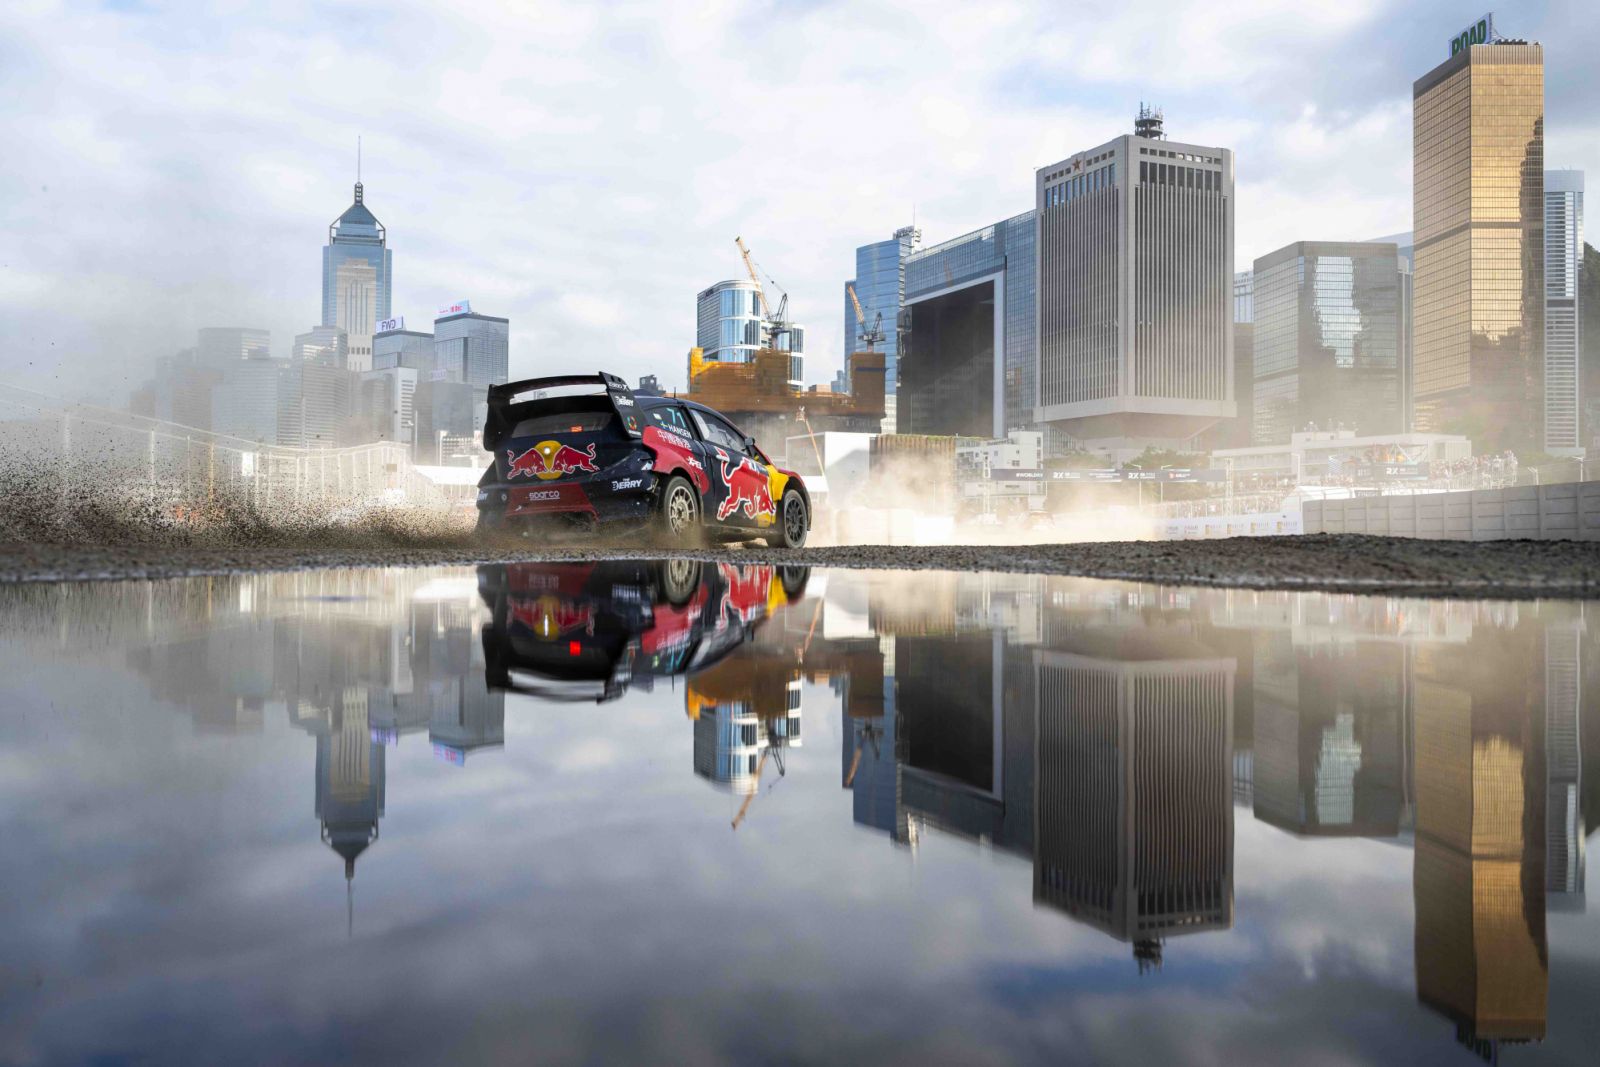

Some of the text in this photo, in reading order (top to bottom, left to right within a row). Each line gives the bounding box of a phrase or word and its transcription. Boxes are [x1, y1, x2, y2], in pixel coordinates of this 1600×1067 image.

[381, 319, 396, 331] FWD
[666, 408, 686, 428] 71
[668, 424, 692, 440] HANSEN
[611, 480, 643, 491] BERRY
[529, 491, 560, 500] sparco
